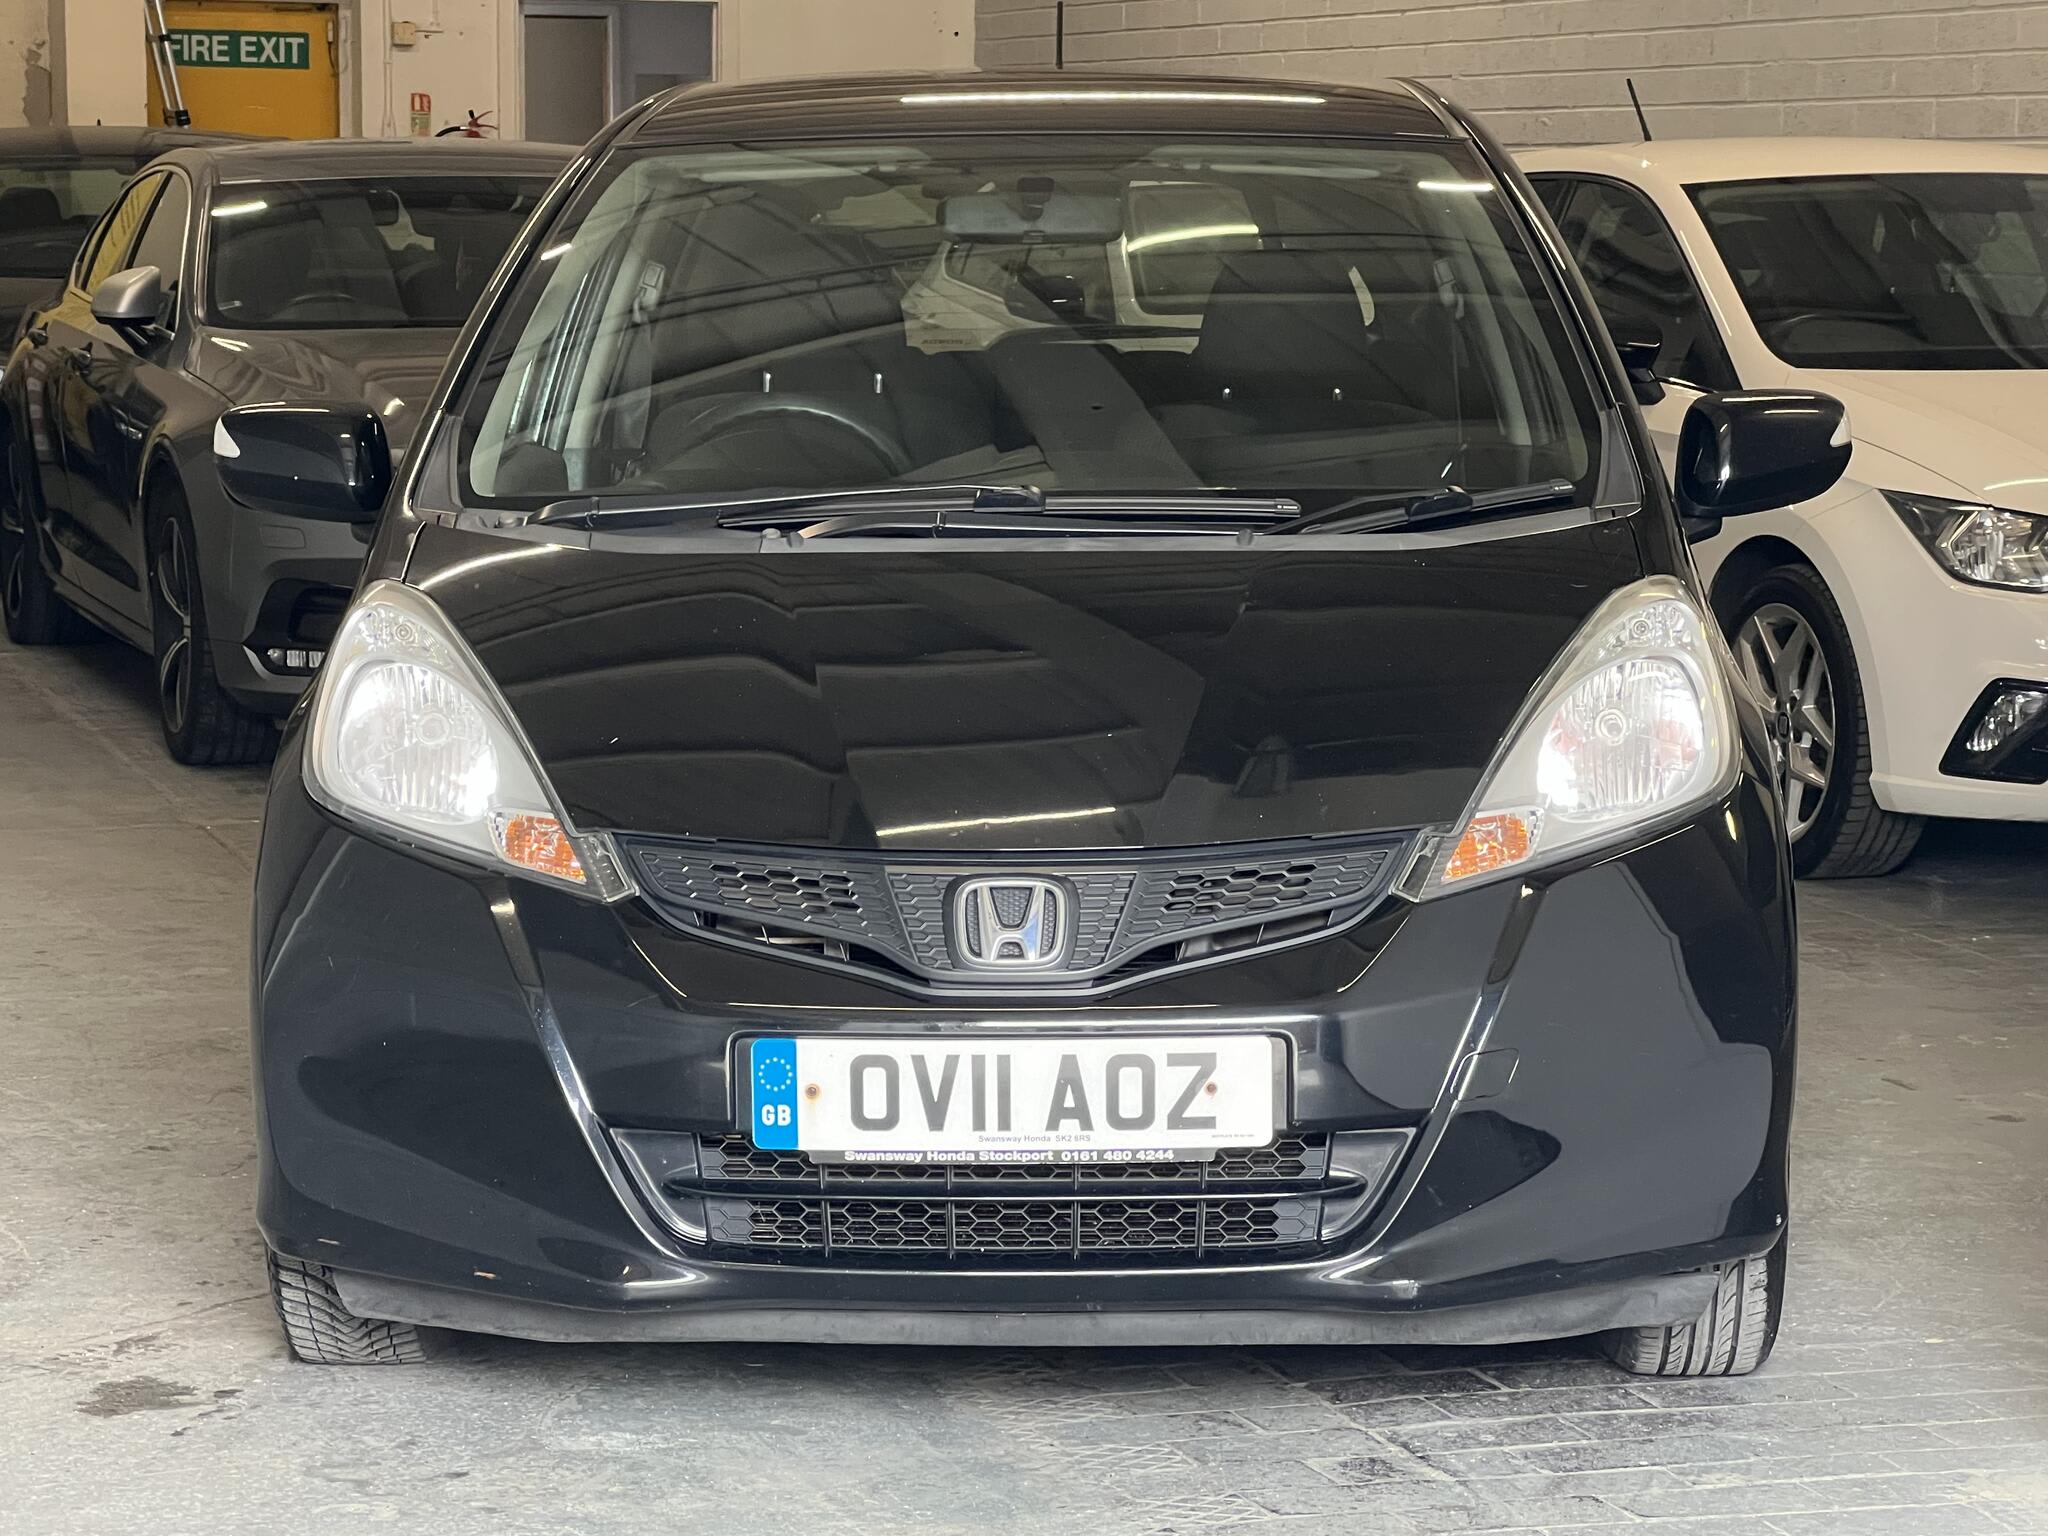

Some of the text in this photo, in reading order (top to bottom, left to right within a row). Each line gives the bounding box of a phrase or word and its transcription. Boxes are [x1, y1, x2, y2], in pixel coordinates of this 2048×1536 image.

[240, 36, 305, 64] EXIT
[850, 1052, 1217, 1132] OV11 AOZ
[761, 1104, 791, 1126] GB
[979, 1135, 1021, 1144] Swansway
[1024, 1134, 1051, 1142] Honda
[1055, 1134, 1072, 1142] SK2
[844, 1149, 1174, 1163] Swansway Honda Stockport 0161 480 4244
